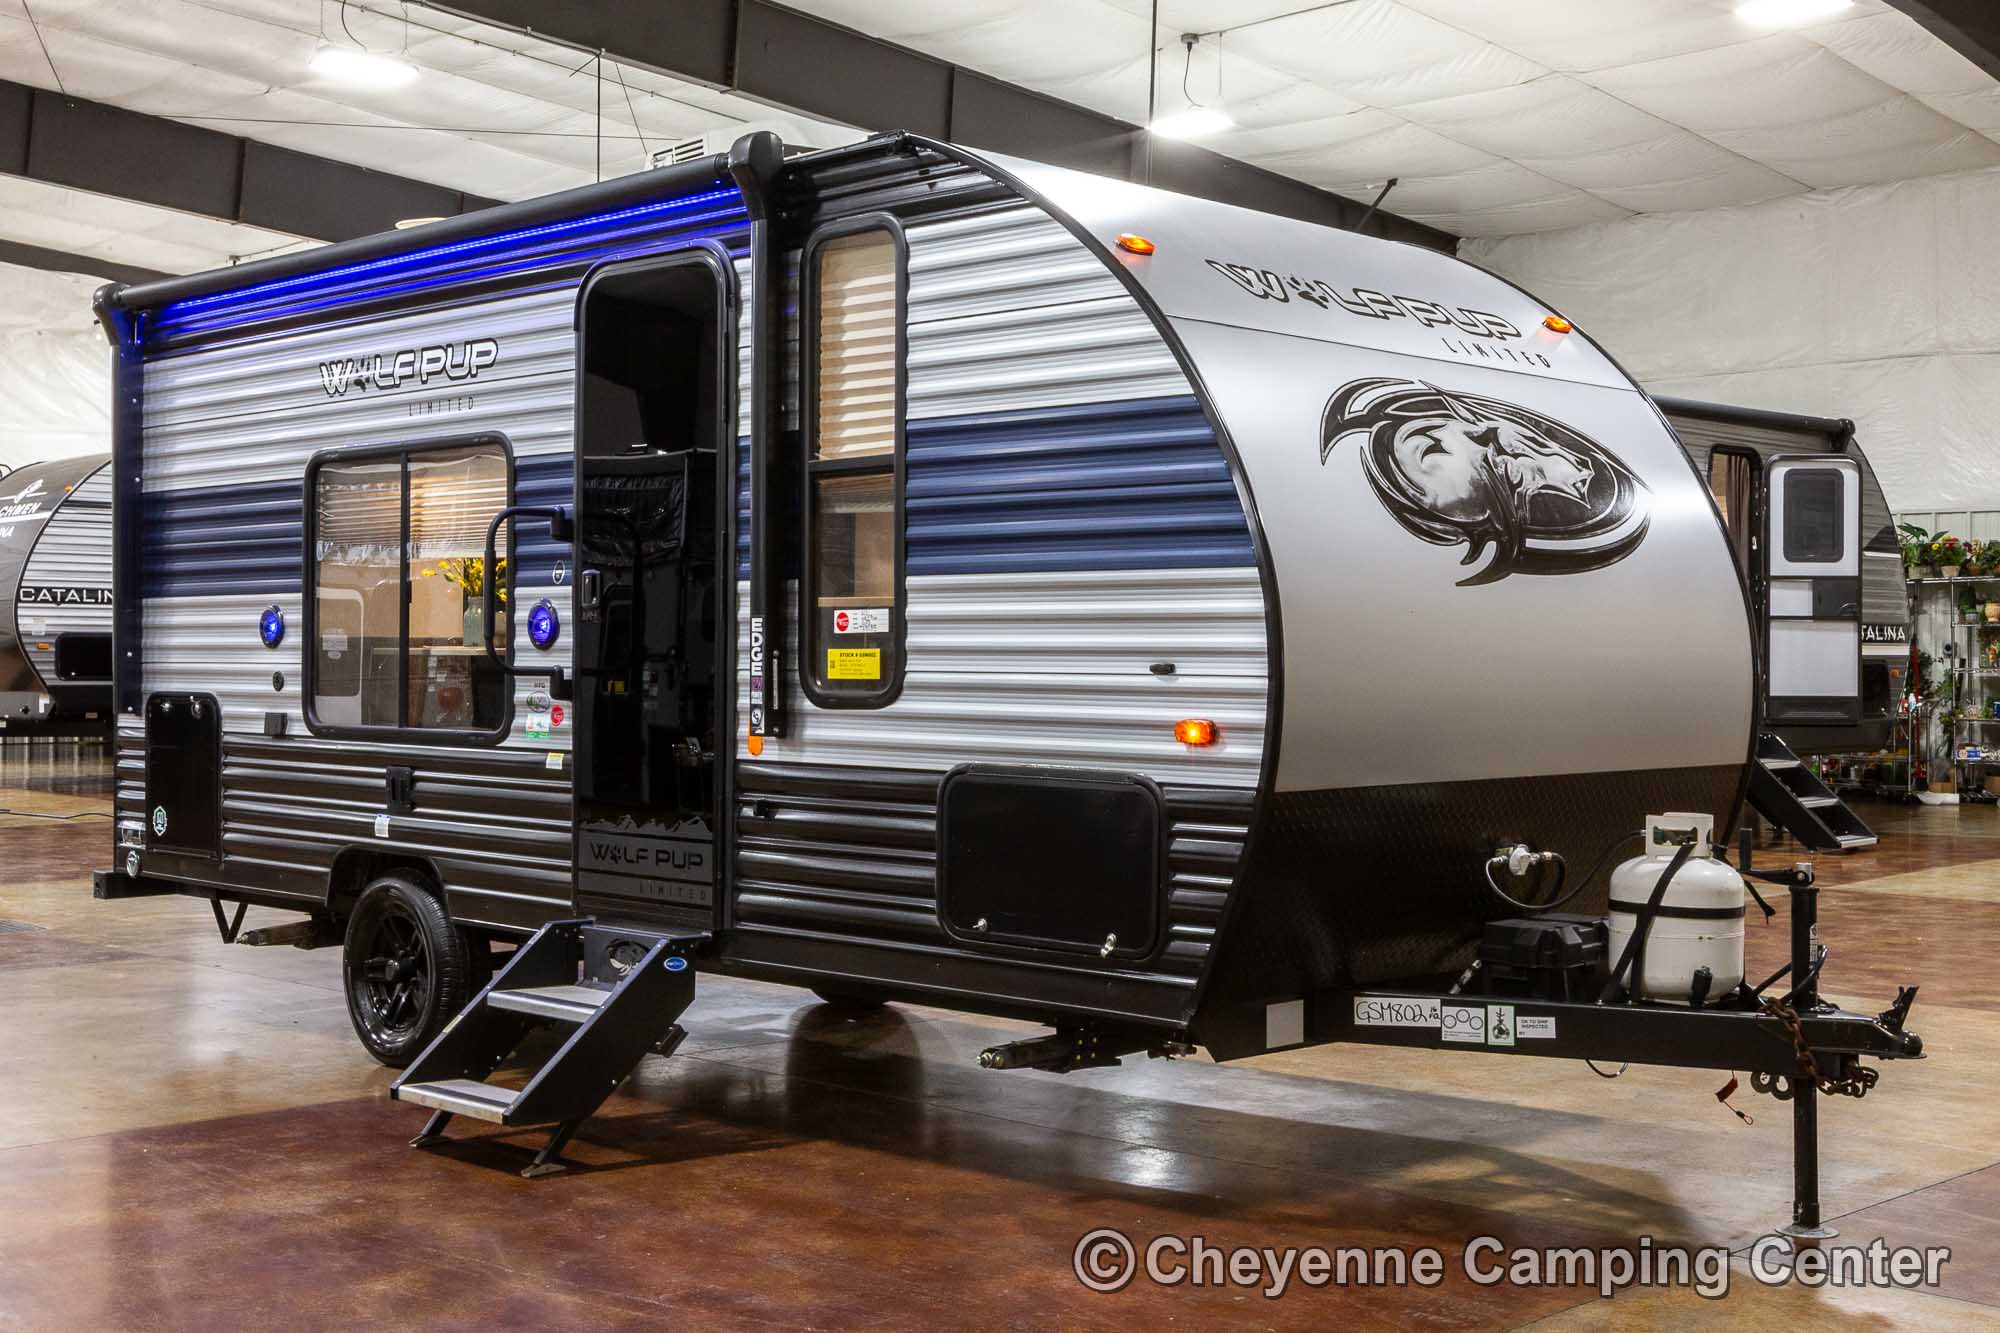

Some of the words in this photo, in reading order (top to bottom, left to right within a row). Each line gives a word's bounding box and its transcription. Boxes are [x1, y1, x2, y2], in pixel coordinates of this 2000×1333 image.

[409, 396, 474, 416] LIMITED
[750, 617, 763, 677] EDGE
[655, 848, 704, 870] PUP
[639, 879, 707, 901] LIMITED
[1356, 1001, 1428, 1024] GSM802
